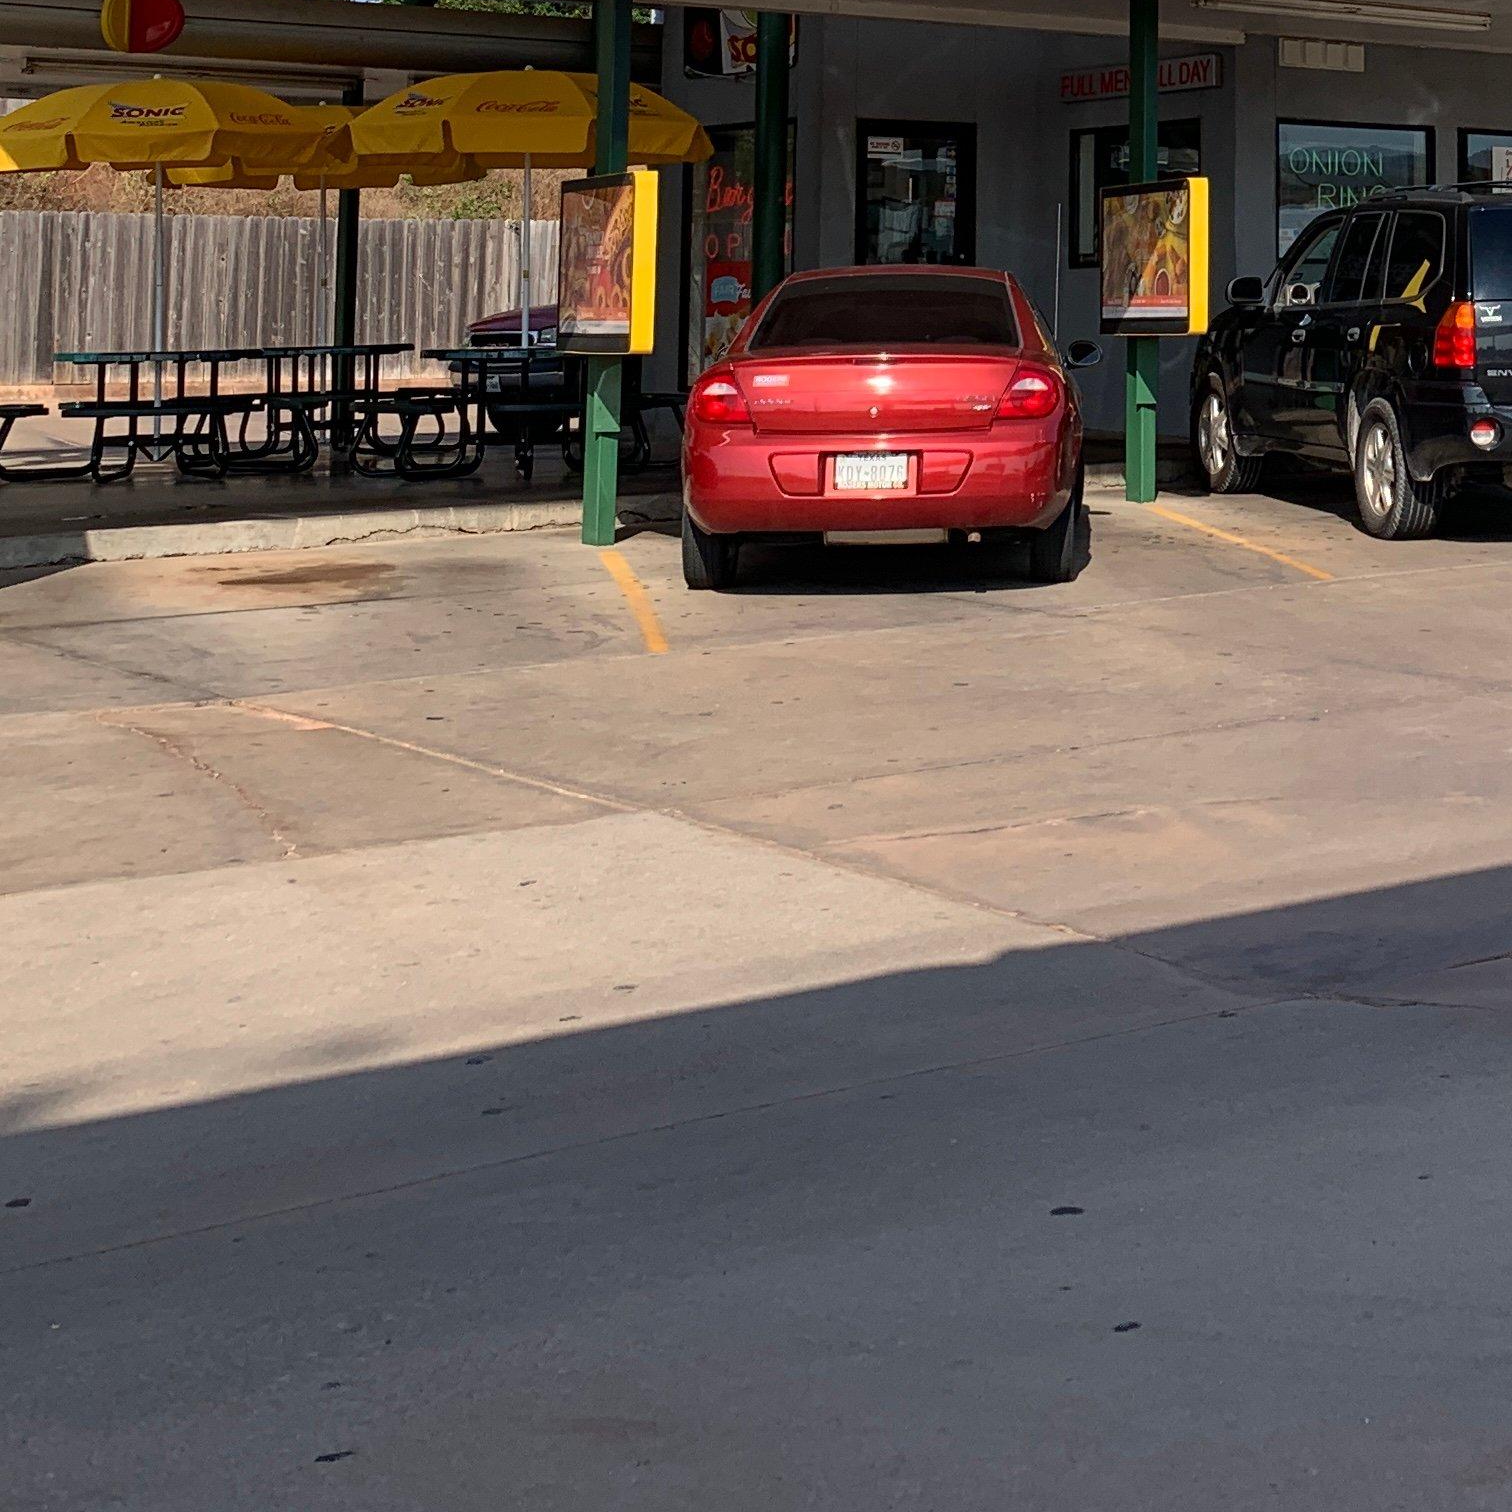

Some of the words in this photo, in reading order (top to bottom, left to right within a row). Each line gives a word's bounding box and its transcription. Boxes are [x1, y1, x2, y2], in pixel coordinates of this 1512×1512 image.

[1061, 74, 1097, 97] FULL
[1100, 69, 1132, 93] MEN
[1159, 63, 1176, 87] LL
[1179, 58, 1211, 85] DAY
[110, 106, 186, 119] SONIC
[1290, 148, 1384, 177] ONION
